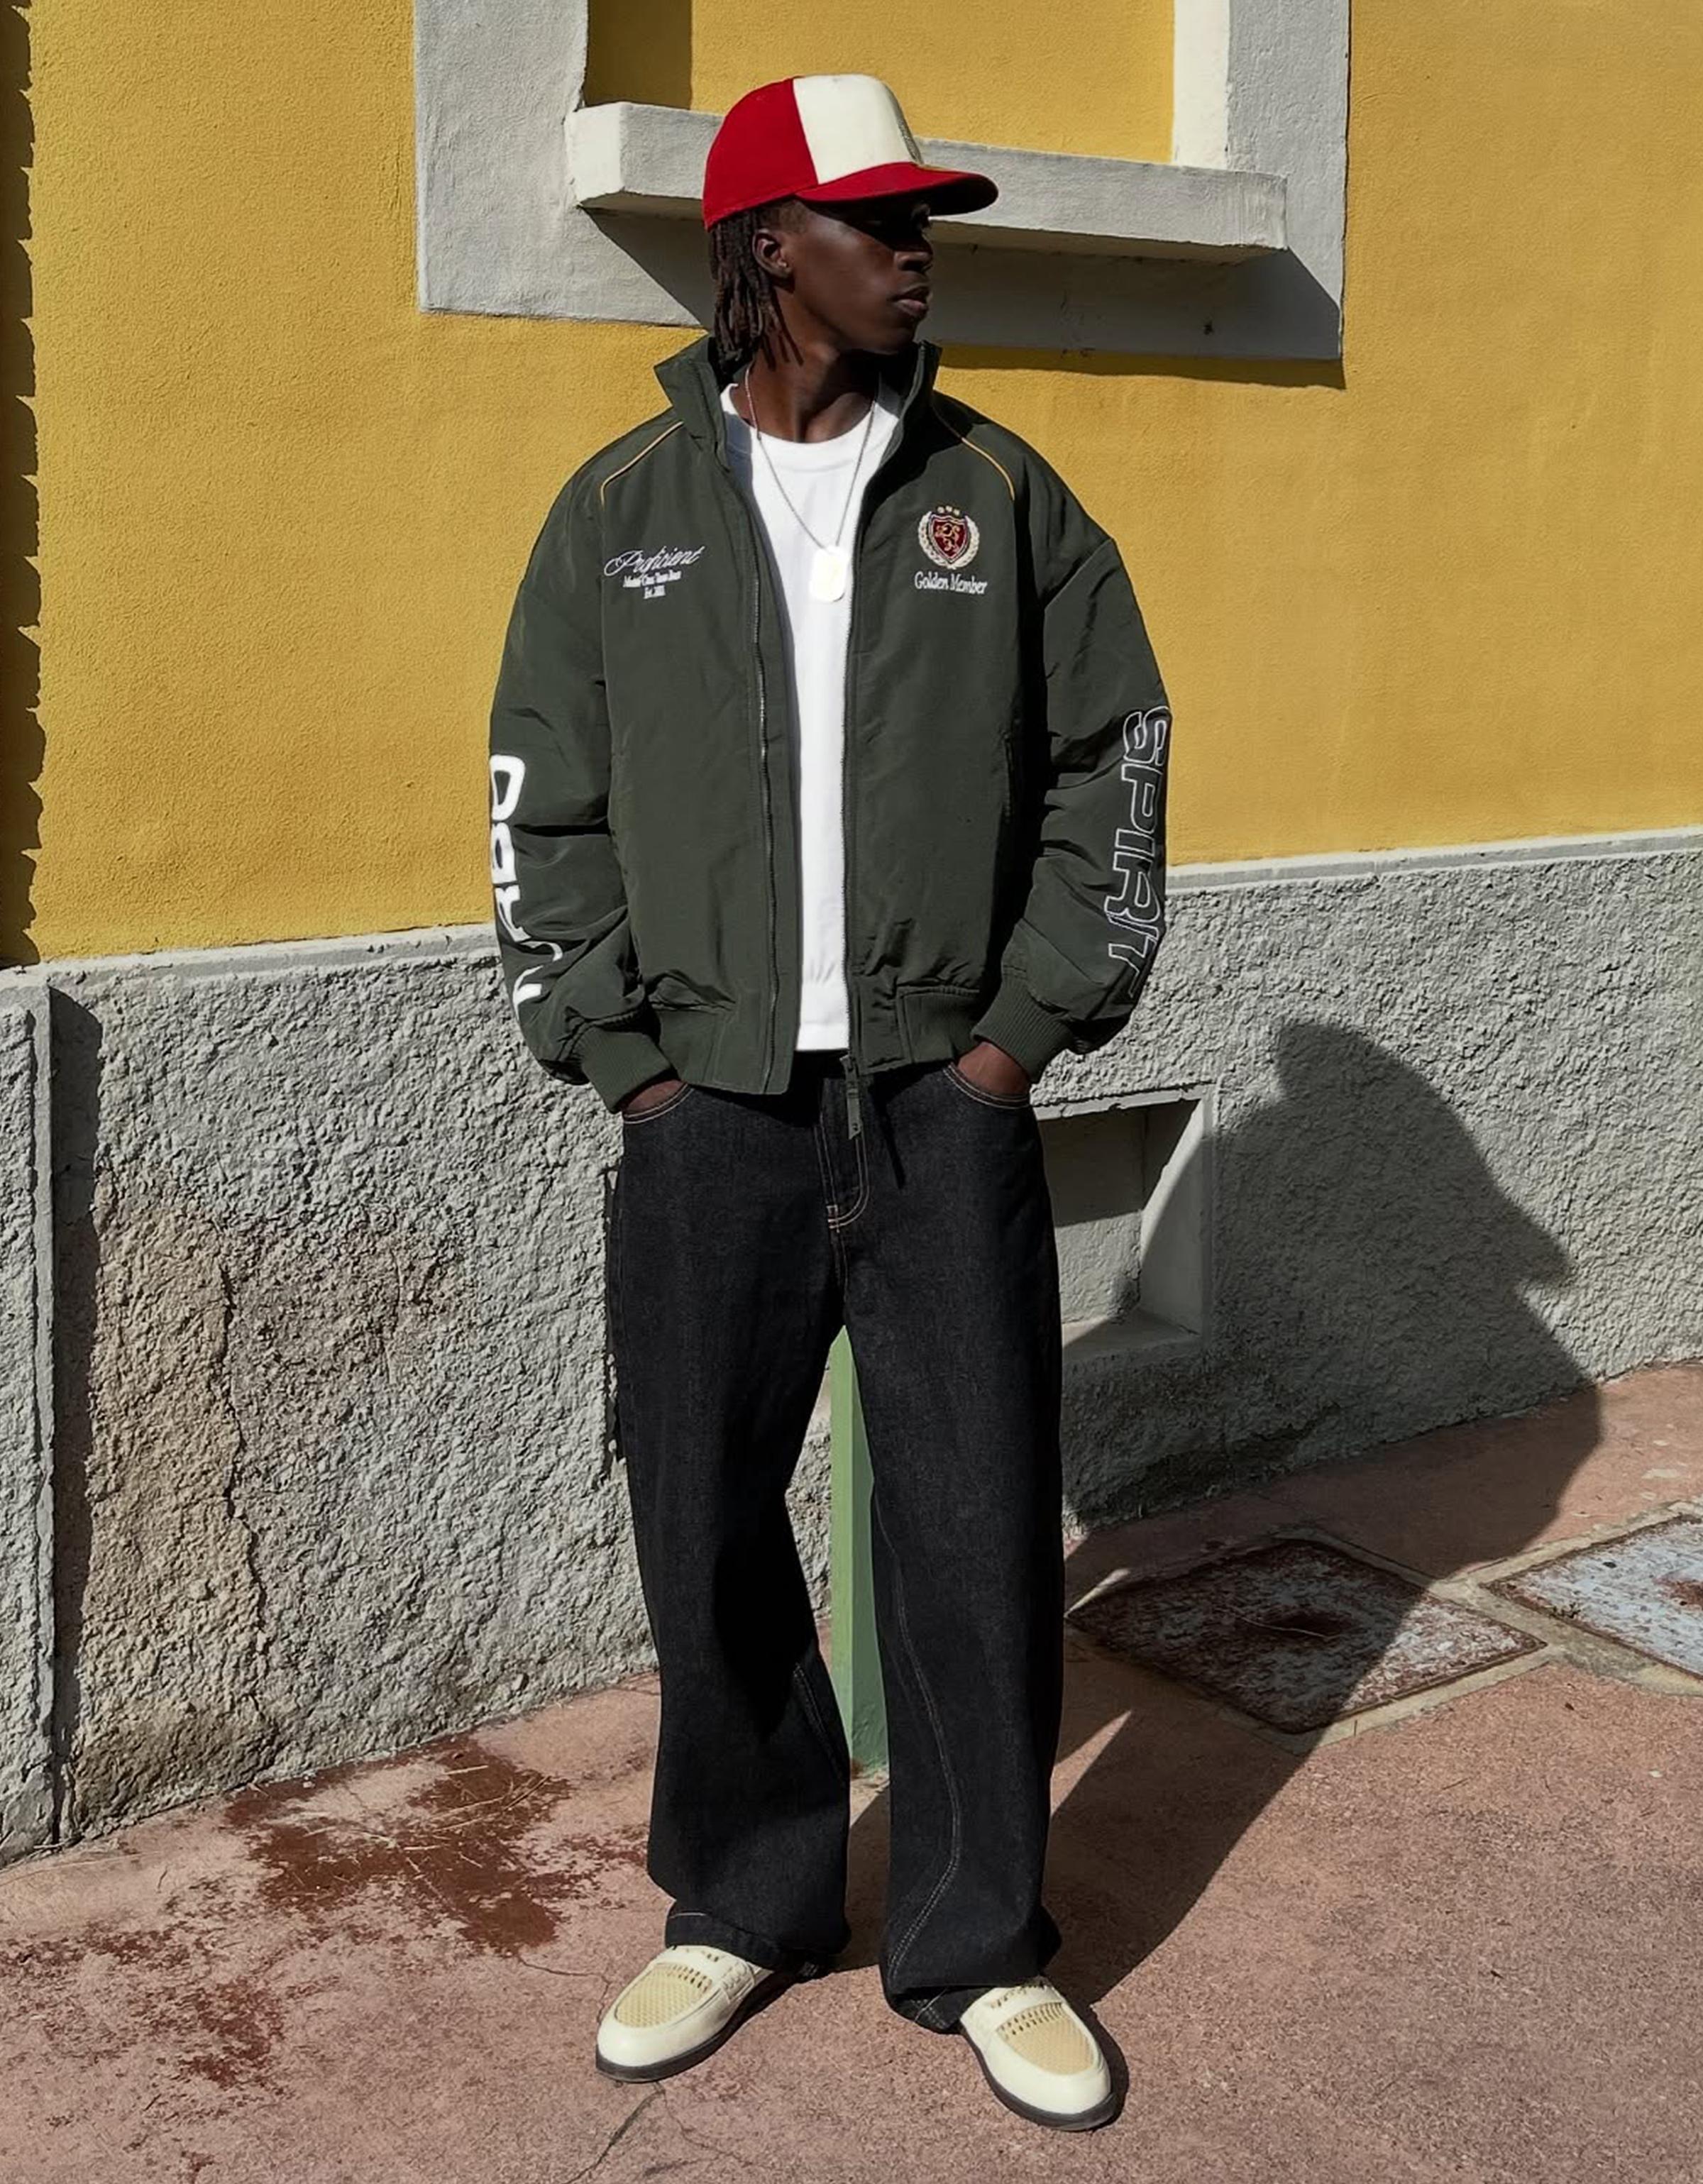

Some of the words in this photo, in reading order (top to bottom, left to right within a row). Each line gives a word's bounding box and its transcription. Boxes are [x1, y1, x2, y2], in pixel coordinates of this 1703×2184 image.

[914, 570, 949, 590] Golden
[949, 573, 988, 595] Member
[1104, 705, 1170, 998] SPIRIT
